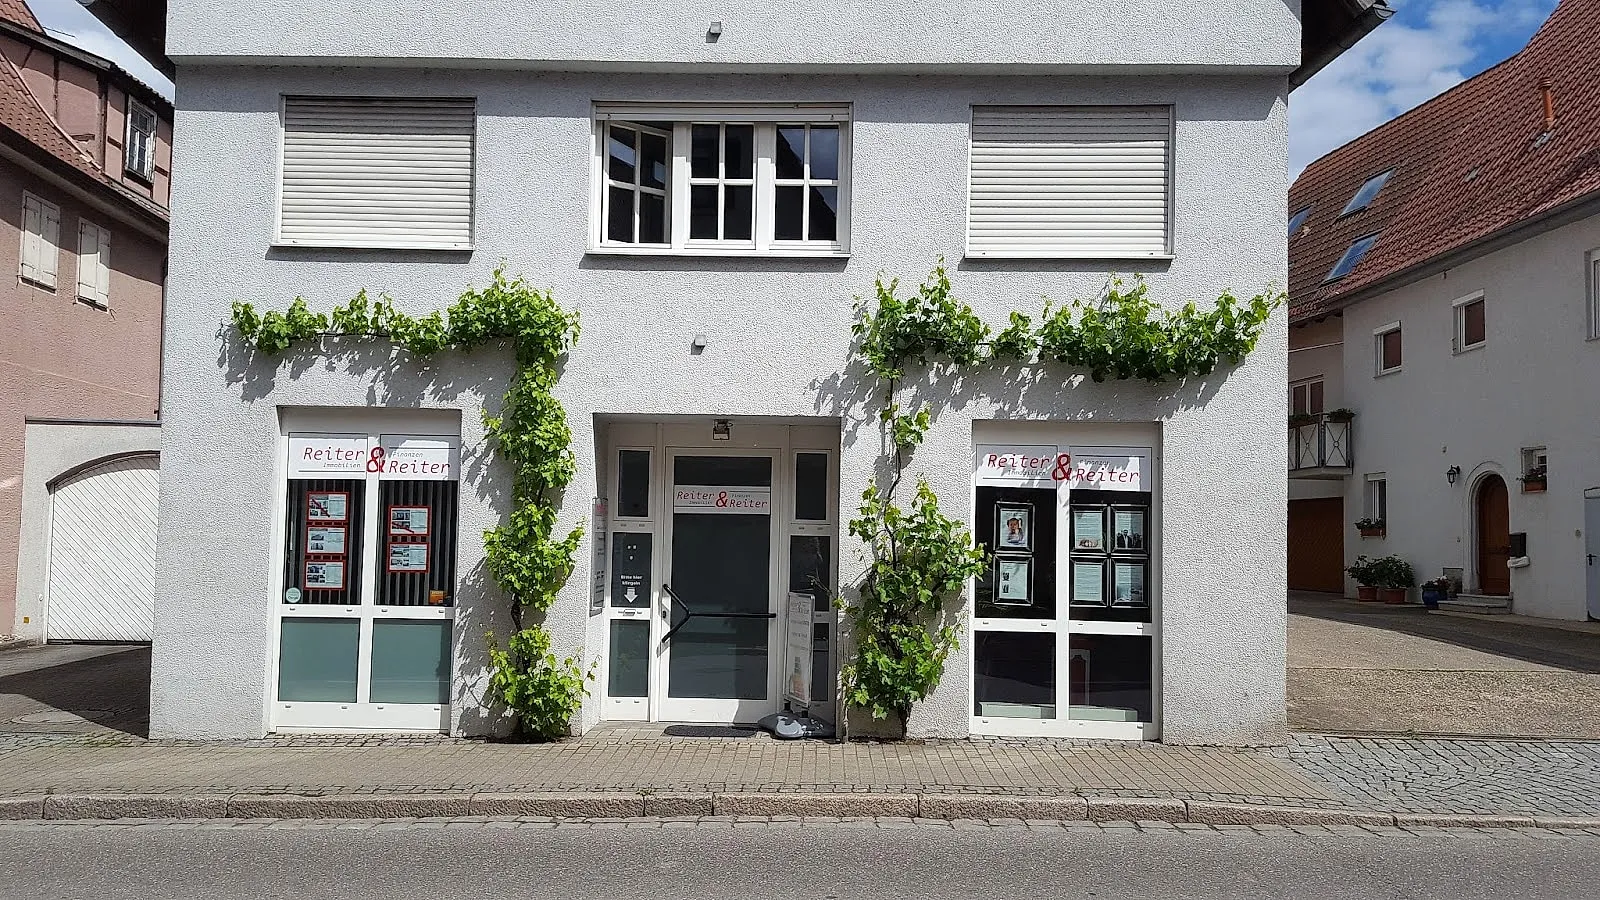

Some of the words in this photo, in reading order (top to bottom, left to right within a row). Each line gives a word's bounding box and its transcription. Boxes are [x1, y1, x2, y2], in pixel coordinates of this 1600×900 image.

[303, 446, 365, 461] Reiter
[366, 446, 386, 473] &
[388, 459, 451, 474] Reiter
[987, 453, 1051, 469] Reiter
[1052, 453, 1073, 481] &
[1075, 467, 1140, 483] Reiter
[676, 490, 715, 500] Reiter
[715, 491, 728, 508] &
[729, 498, 768, 508] Reiter
